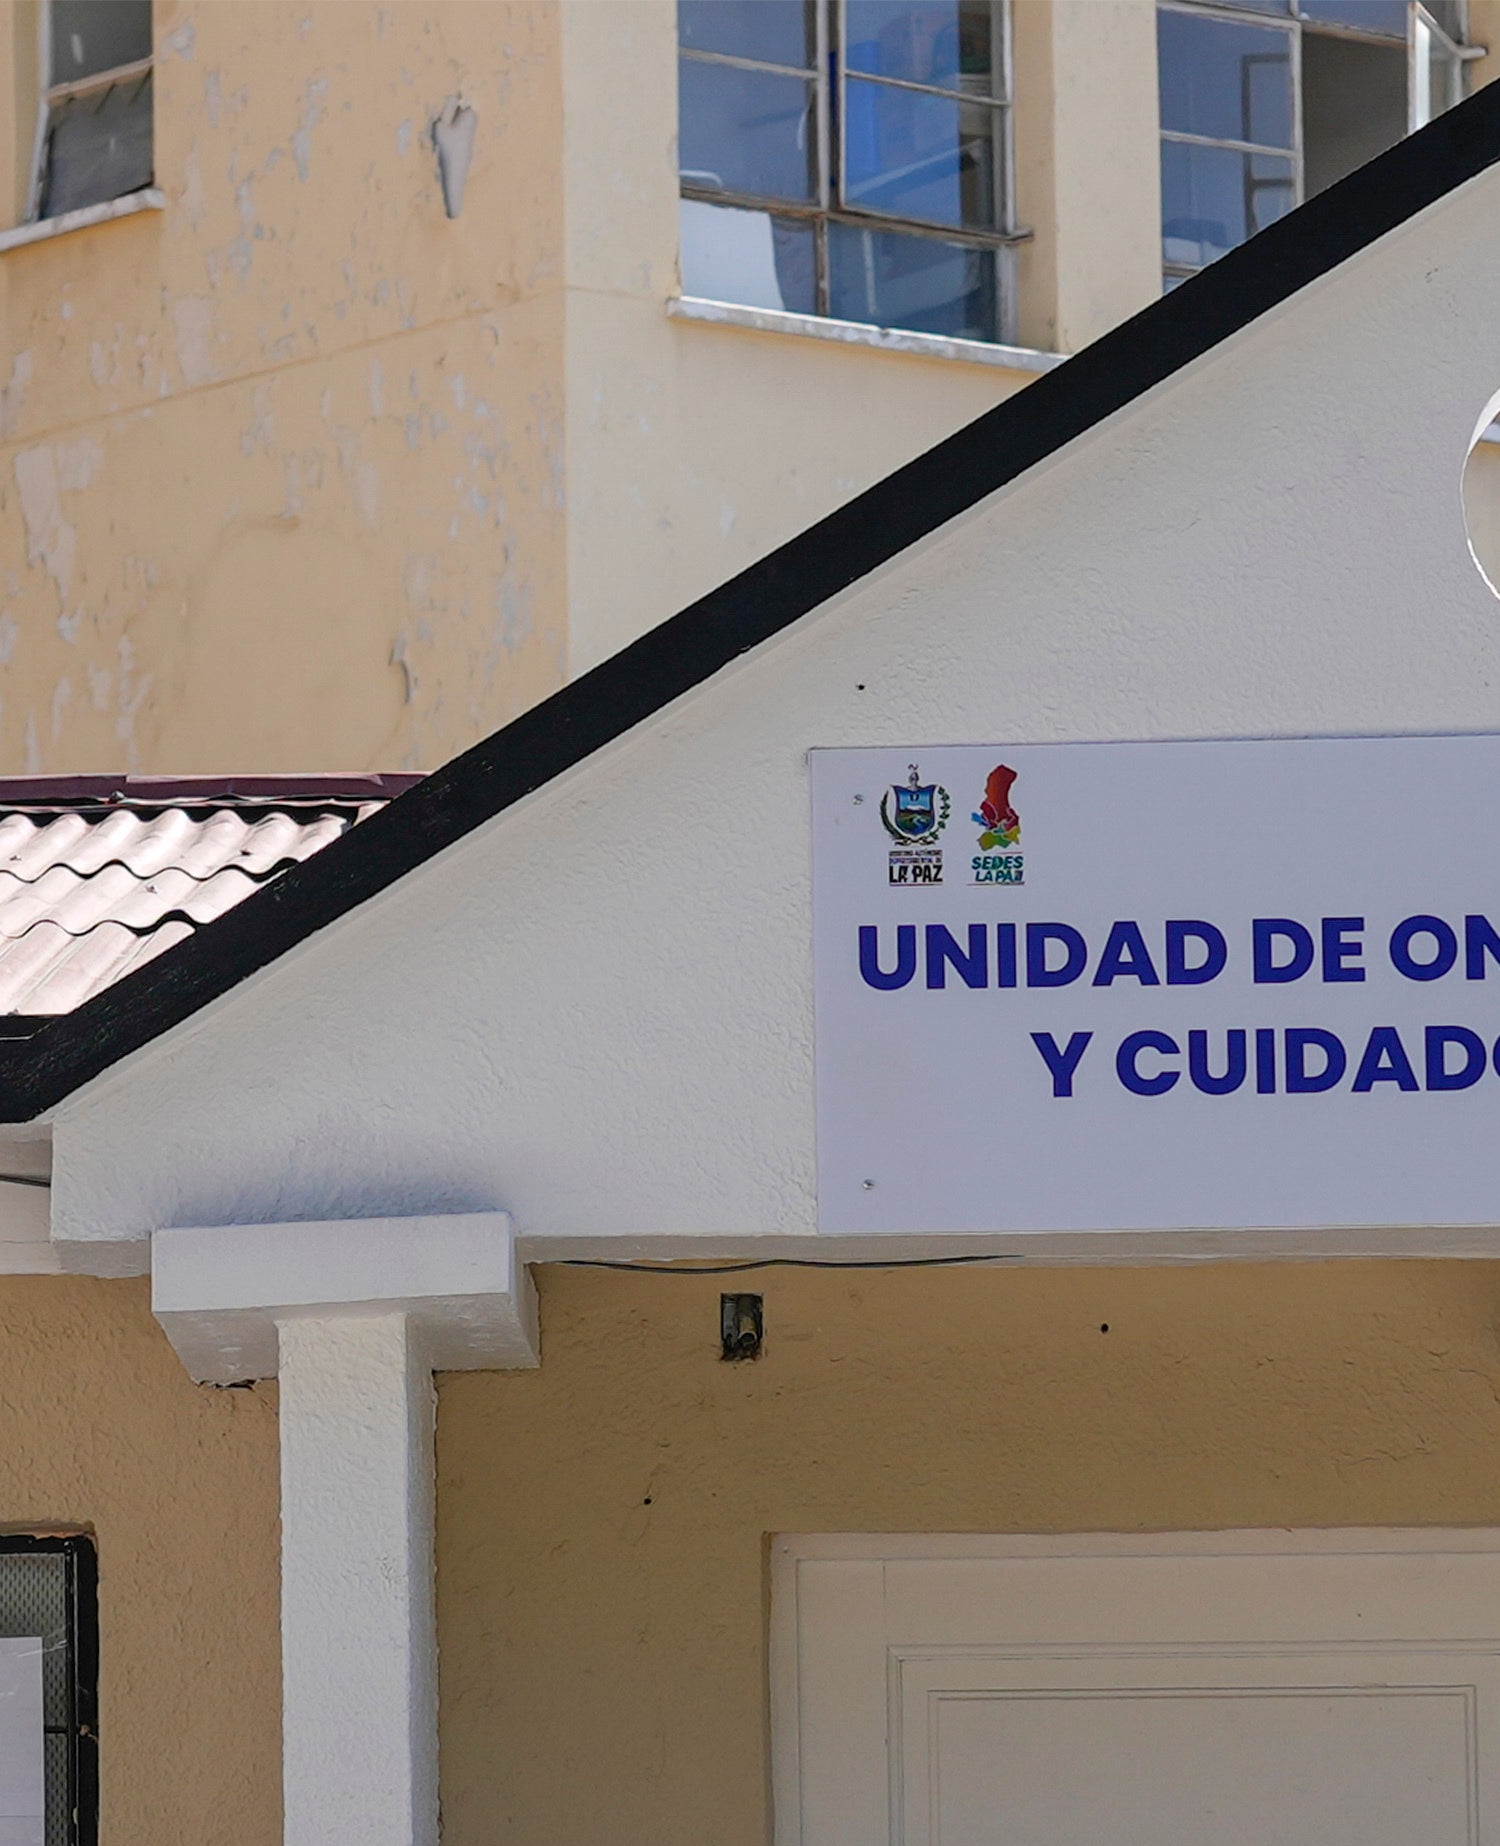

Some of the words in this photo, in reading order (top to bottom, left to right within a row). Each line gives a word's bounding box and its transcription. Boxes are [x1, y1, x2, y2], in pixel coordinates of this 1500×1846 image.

[972, 856, 1023, 870] SEDES
[890, 865, 907, 882] LA
[912, 865, 942, 882] PAZ
[976, 871, 992, 881] LA
[858, 915, 1228, 991] UNIDAD
[1252, 916, 1366, 985] DE
[1031, 1031, 1093, 1099] Y
